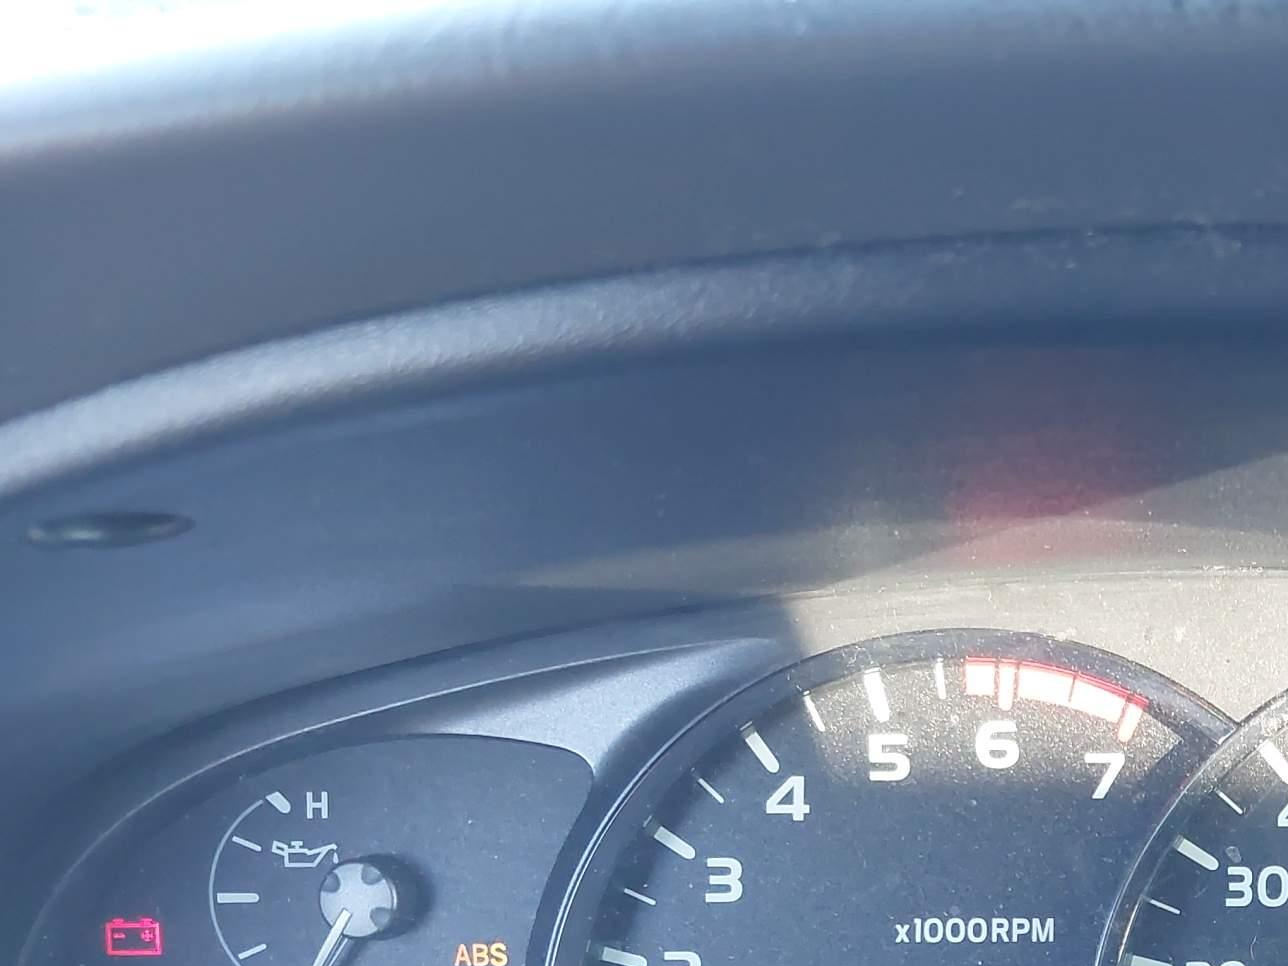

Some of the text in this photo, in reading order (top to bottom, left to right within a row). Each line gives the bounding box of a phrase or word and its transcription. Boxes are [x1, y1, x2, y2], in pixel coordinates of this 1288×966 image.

[868, 735, 910, 781] 5
[975, 721, 1020, 768] 6
[765, 776, 810, 821] 4
[1085, 754, 1126, 799] 7
[306, 792, 329, 819] H
[705, 857, 743, 902] 3
[453, 943, 508, 966] ABS
